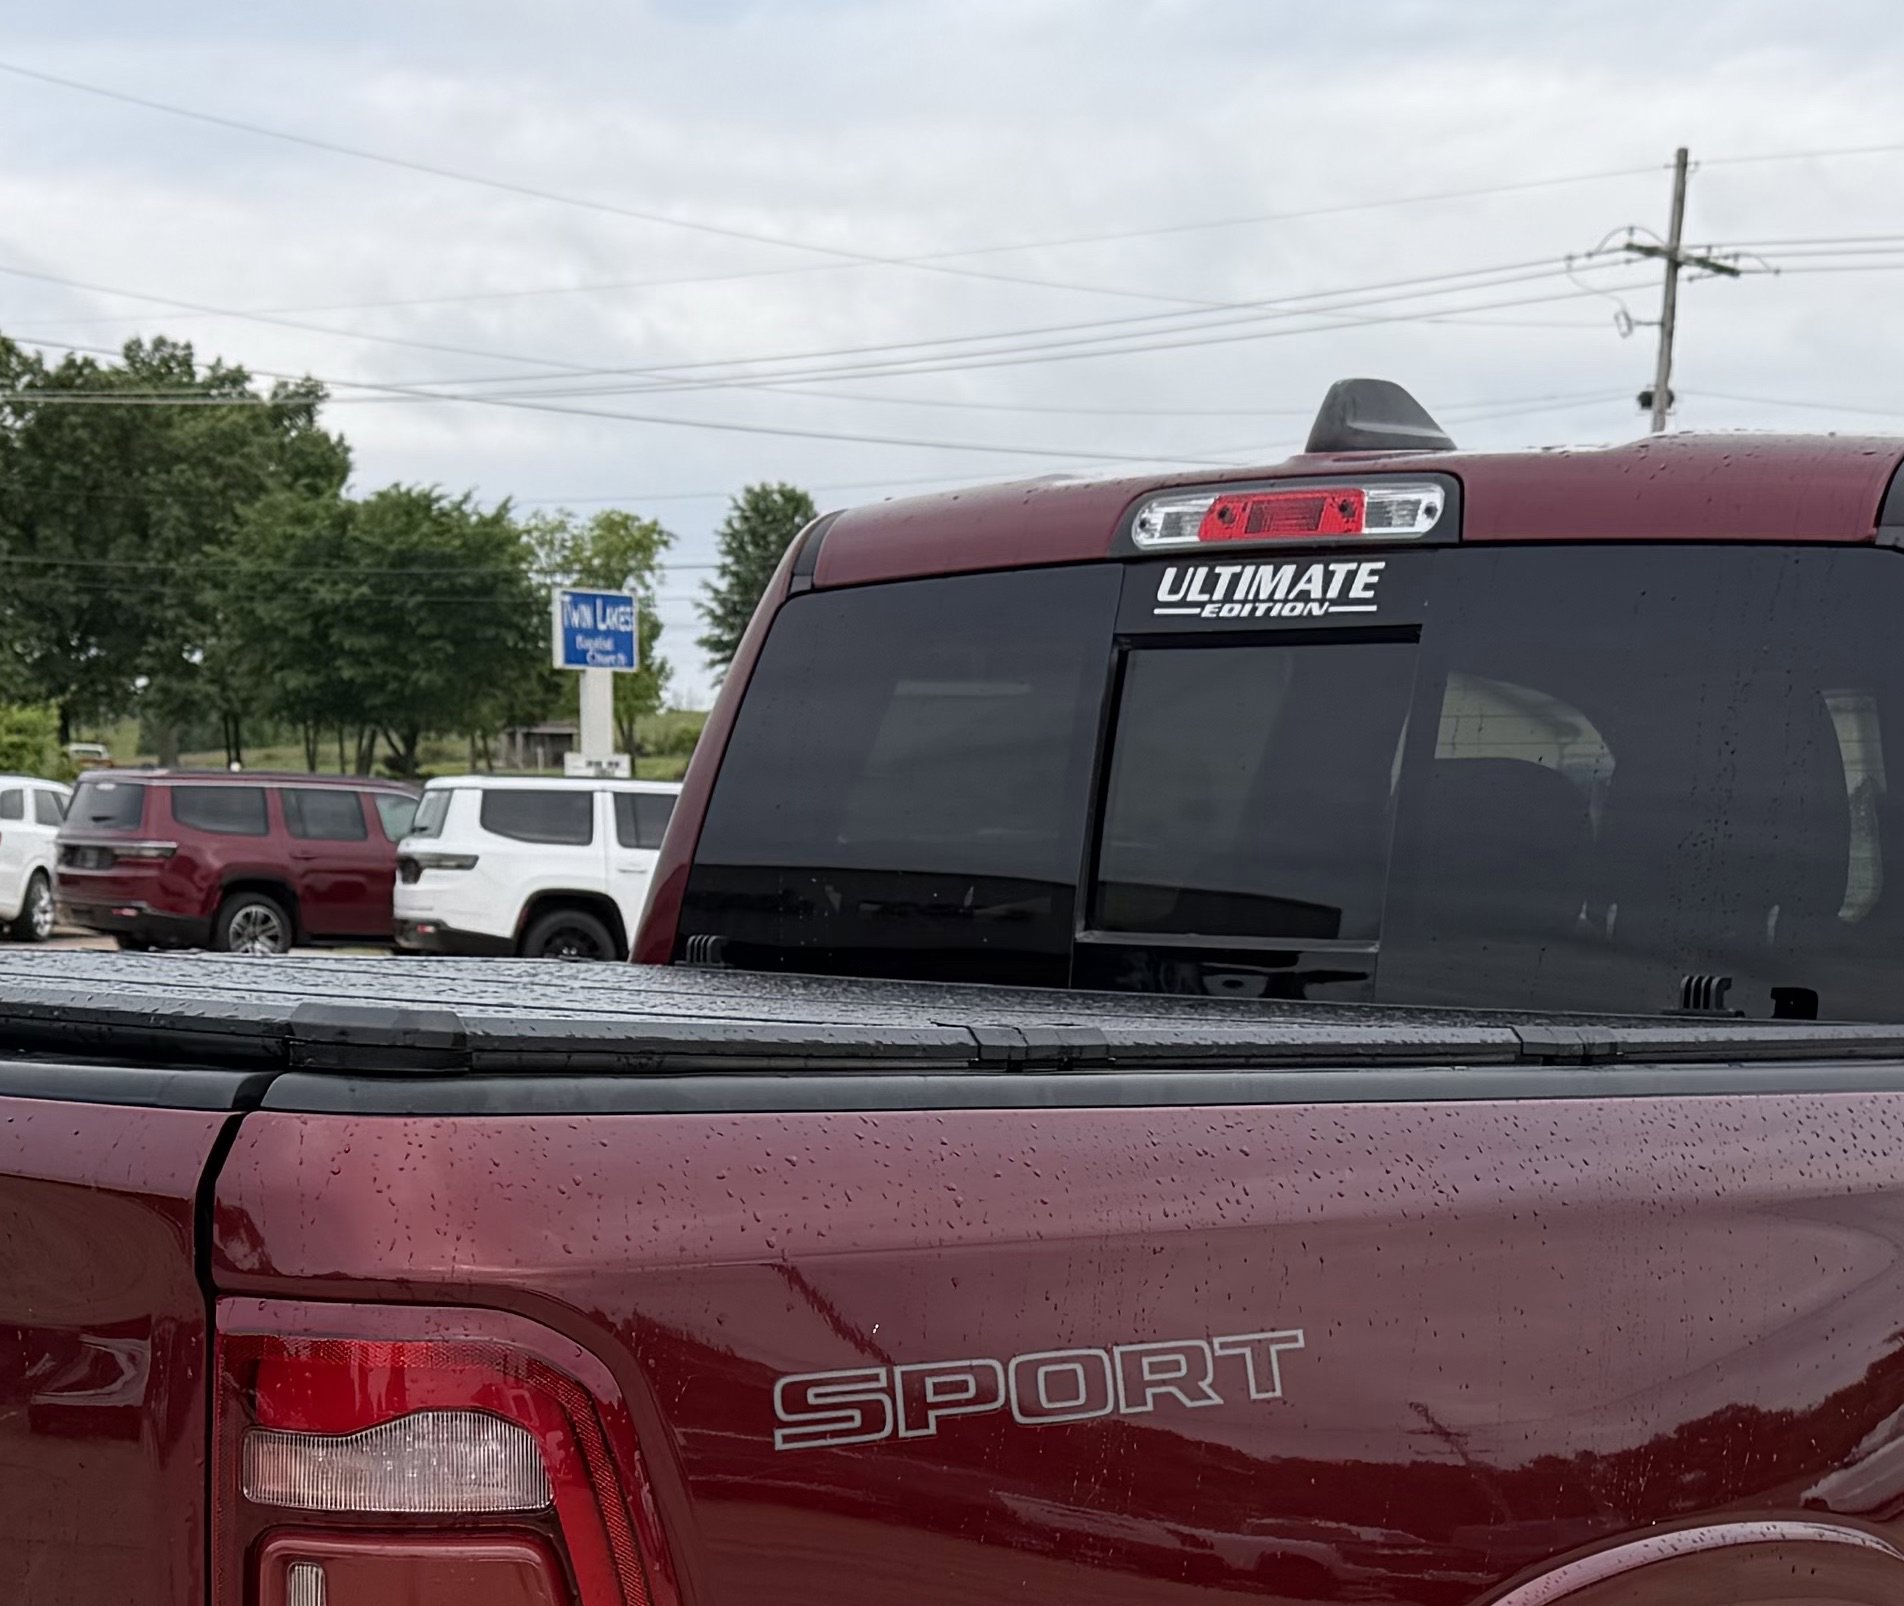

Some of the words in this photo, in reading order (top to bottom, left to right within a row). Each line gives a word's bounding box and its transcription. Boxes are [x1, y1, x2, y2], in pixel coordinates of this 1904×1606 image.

[1156, 561, 1386, 602] ULTIMATE
[1200, 601, 1330, 618] EDITION
[773, 1328, 1304, 1451] SPORT
